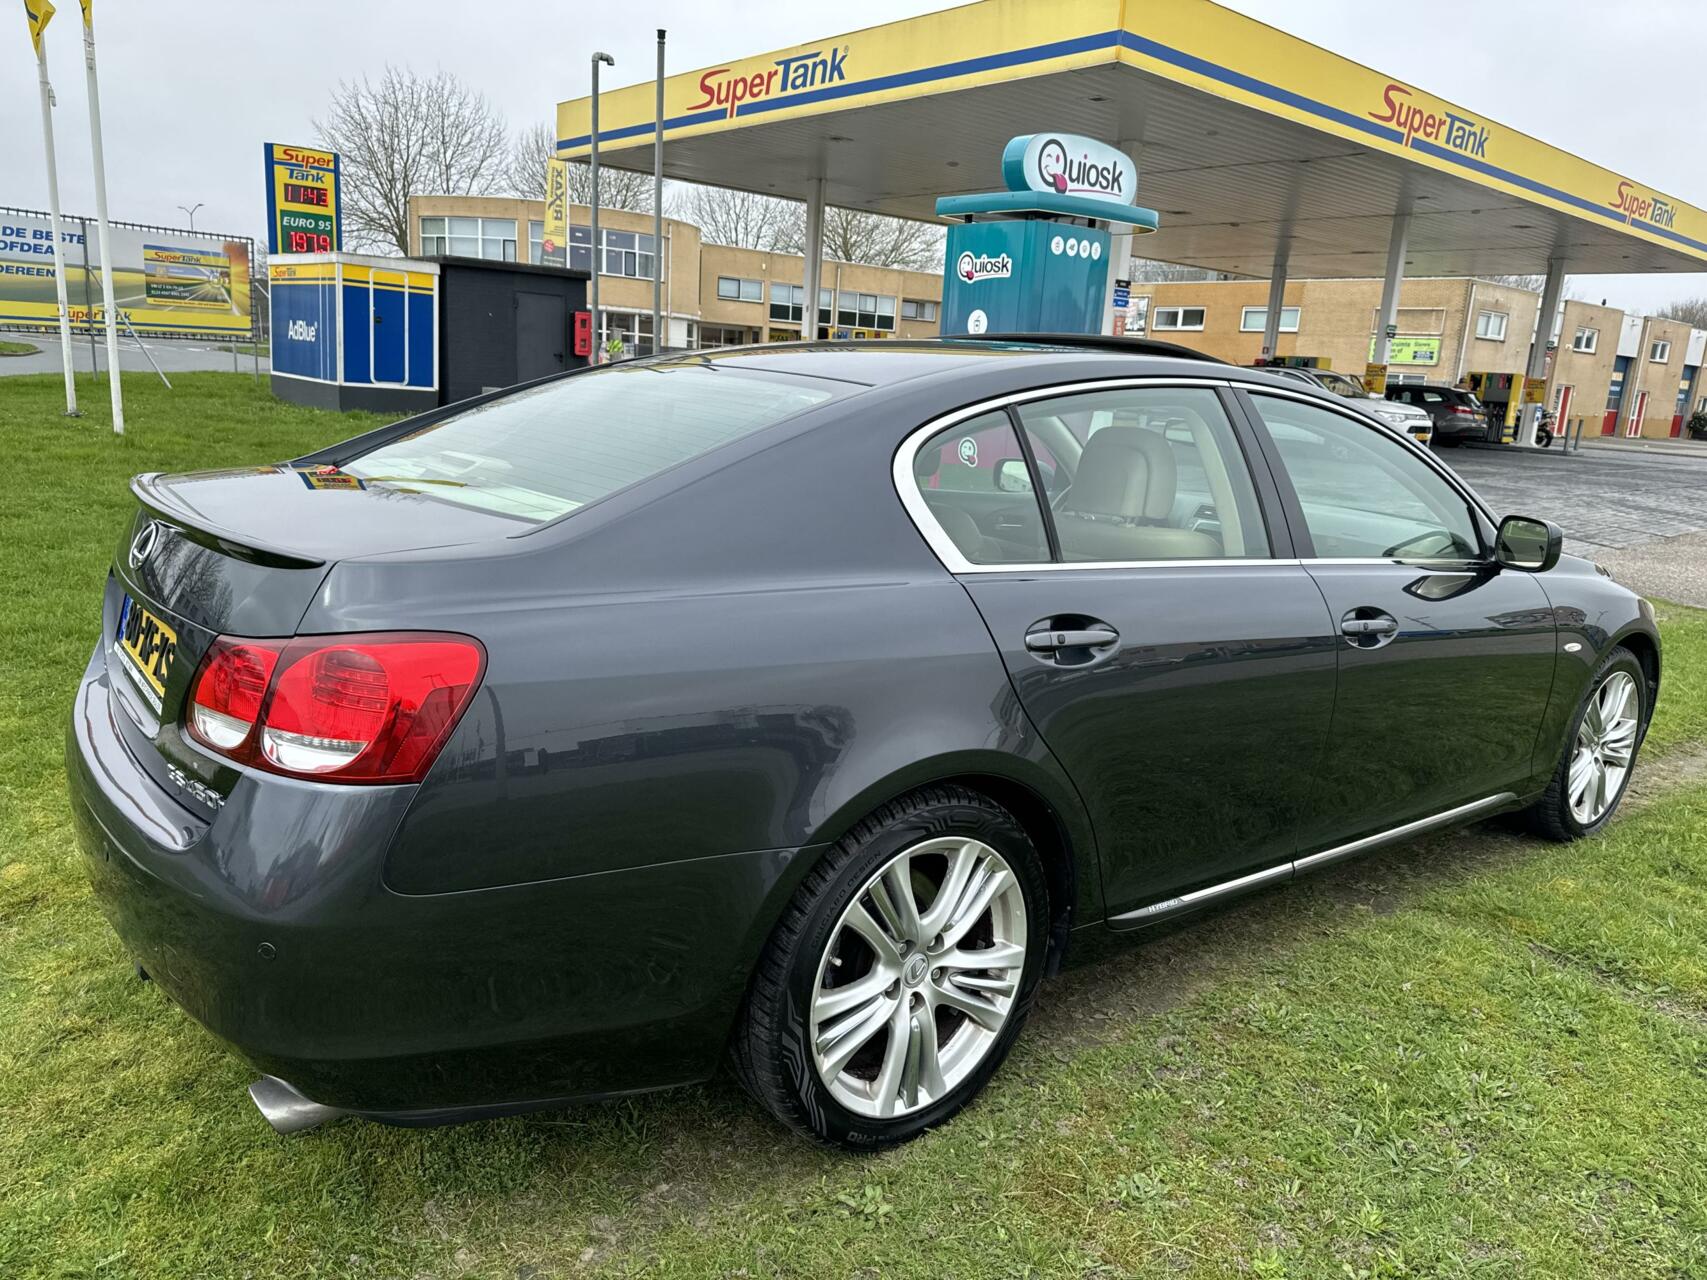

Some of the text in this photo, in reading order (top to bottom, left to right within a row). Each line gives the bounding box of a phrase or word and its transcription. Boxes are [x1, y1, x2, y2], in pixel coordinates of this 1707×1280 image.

[687, 48, 848, 118] SuperTank
[1368, 84, 1489, 158] SuperTank
[275, 148, 333, 169] Super
[1038, 139, 1123, 194] Quiosk
[284, 167, 326, 184] Tank
[287, 186, 329, 204] 11:43
[1608, 181, 1677, 228] SuperTank
[2, 226, 26, 239] DE
[283, 216, 331, 230] EURO 95
[0, 240, 55, 255] OFDEA
[959, 254, 1010, 280] Quiosk
[1148, 898, 1178, 913] HYBRID
